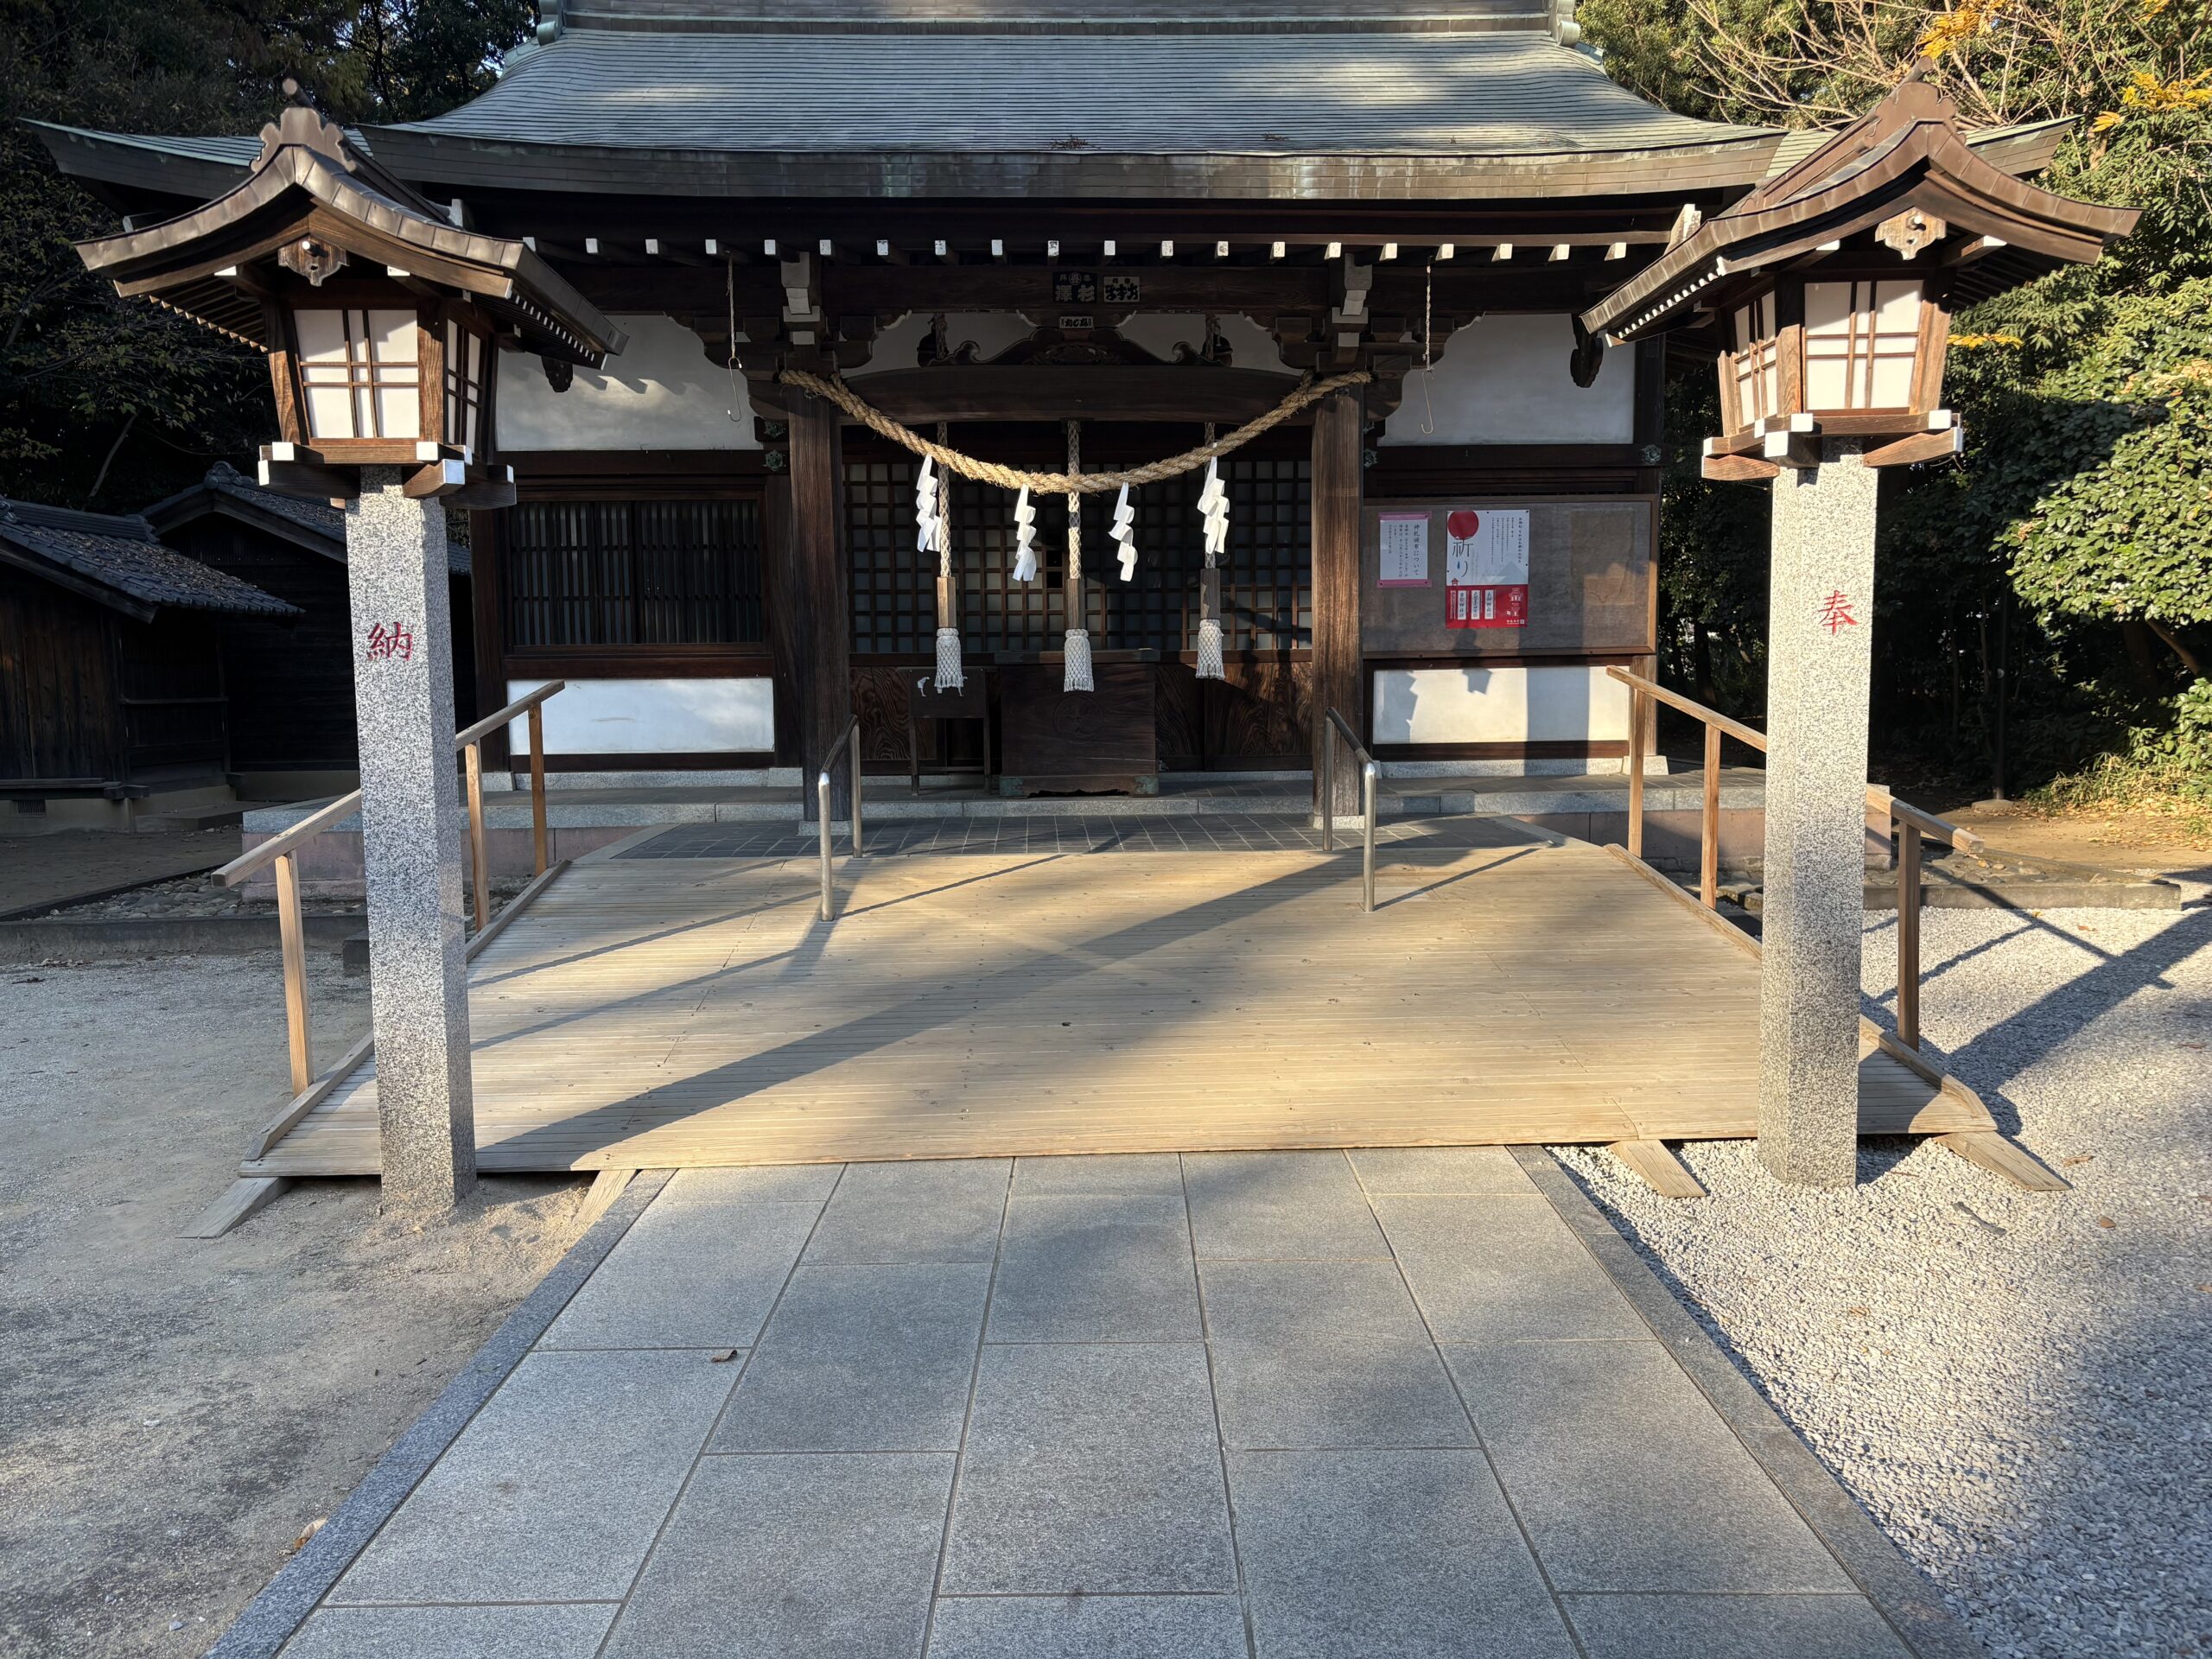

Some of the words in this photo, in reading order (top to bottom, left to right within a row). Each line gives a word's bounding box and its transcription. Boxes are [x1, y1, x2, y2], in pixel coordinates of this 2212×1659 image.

[1452, 535, 1474, 578] 祈り
[1817, 589, 1859, 636] 奉
[366, 621, 413, 662] 納
